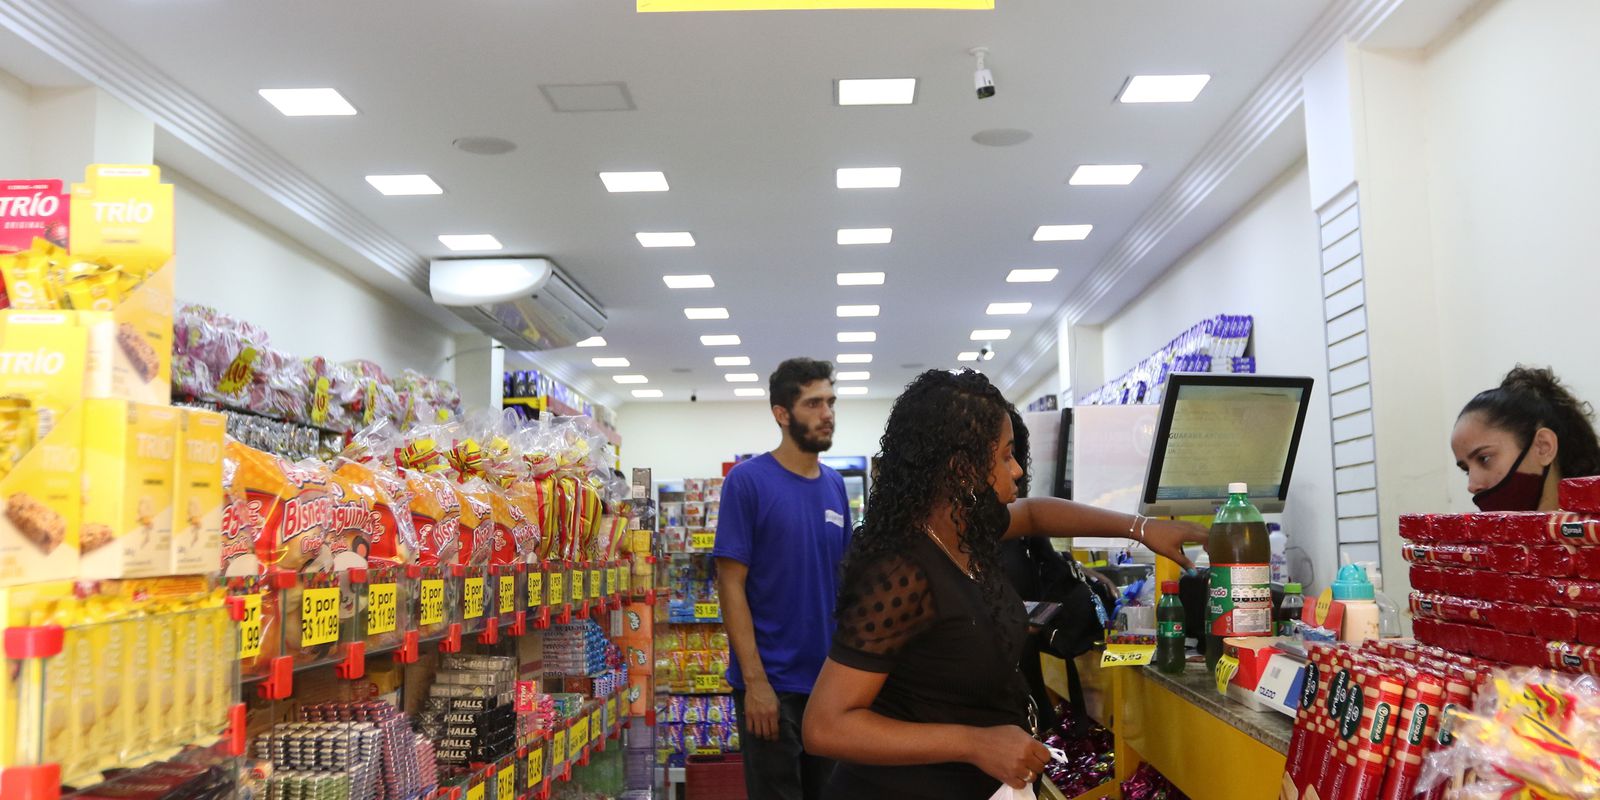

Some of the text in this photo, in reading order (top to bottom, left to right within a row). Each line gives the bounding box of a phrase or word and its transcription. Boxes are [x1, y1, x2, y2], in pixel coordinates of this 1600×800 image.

[422, 586, 441, 601] 3 por
[472, 585, 481, 599] por
[370, 591, 393, 608] 3 por
[305, 597, 335, 617] 3 por
[302, 618, 313, 640] R$
[453, 700, 483, 709] HALLS
[444, 714, 474, 722] HALLS
[447, 728, 477, 736] HALLS
[440, 739, 471, 747] HALLS
[437, 750, 466, 758] HALLS
